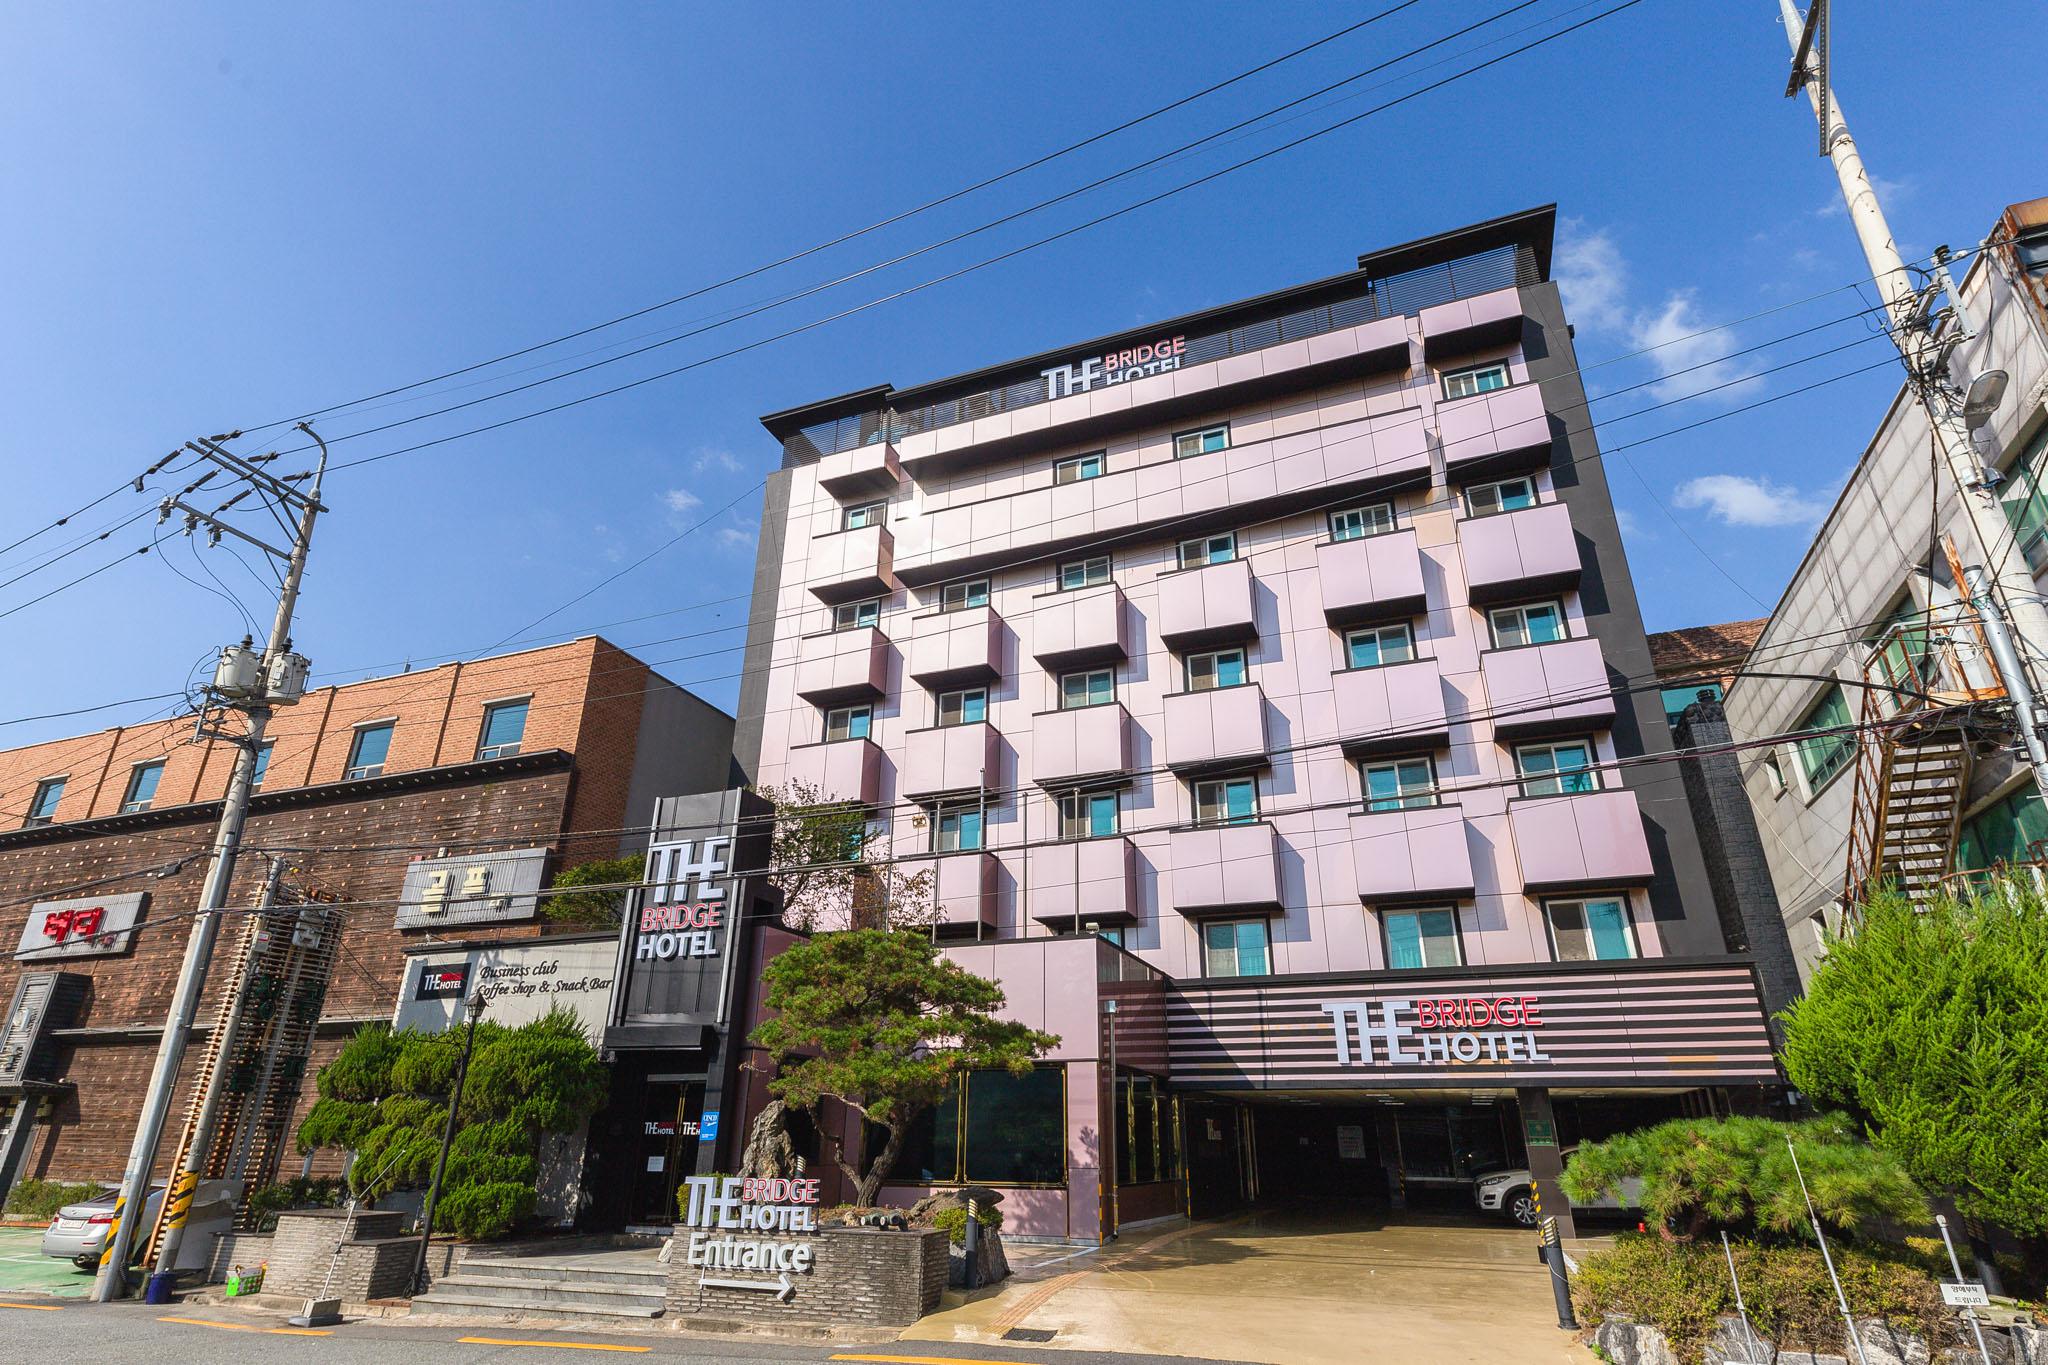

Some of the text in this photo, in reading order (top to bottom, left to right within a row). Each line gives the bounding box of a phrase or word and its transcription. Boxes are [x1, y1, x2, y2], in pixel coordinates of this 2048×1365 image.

[1105, 335, 1186, 371] BRIDGE
[650, 835, 731, 903] THE
[640, 902, 723, 932] BRIDGE
[636, 930, 719, 959] HOTEL
[424, 973, 442, 991] THE
[480, 964, 529, 979] Business
[532, 960, 559, 976] club
[440, 980, 462, 990] HOTEL
[511, 981, 536, 998] shop
[538, 980, 550, 993] &
[551, 976, 590, 993] Snack
[589, 977, 613, 990] Bar
[1417, 996, 1543, 1029] BRIDGE
[1321, 1000, 1420, 1064] THE
[1422, 1031, 1550, 1063] HOTEL
[645, 1122, 659, 1135] THE
[683, 1122, 697, 1135] THE
[684, 1176, 741, 1229] THE
[743, 1178, 821, 1204] BRIDGE
[740, 1204, 817, 1231] HOTEL
[687, 1231, 814, 1271] Entrance
